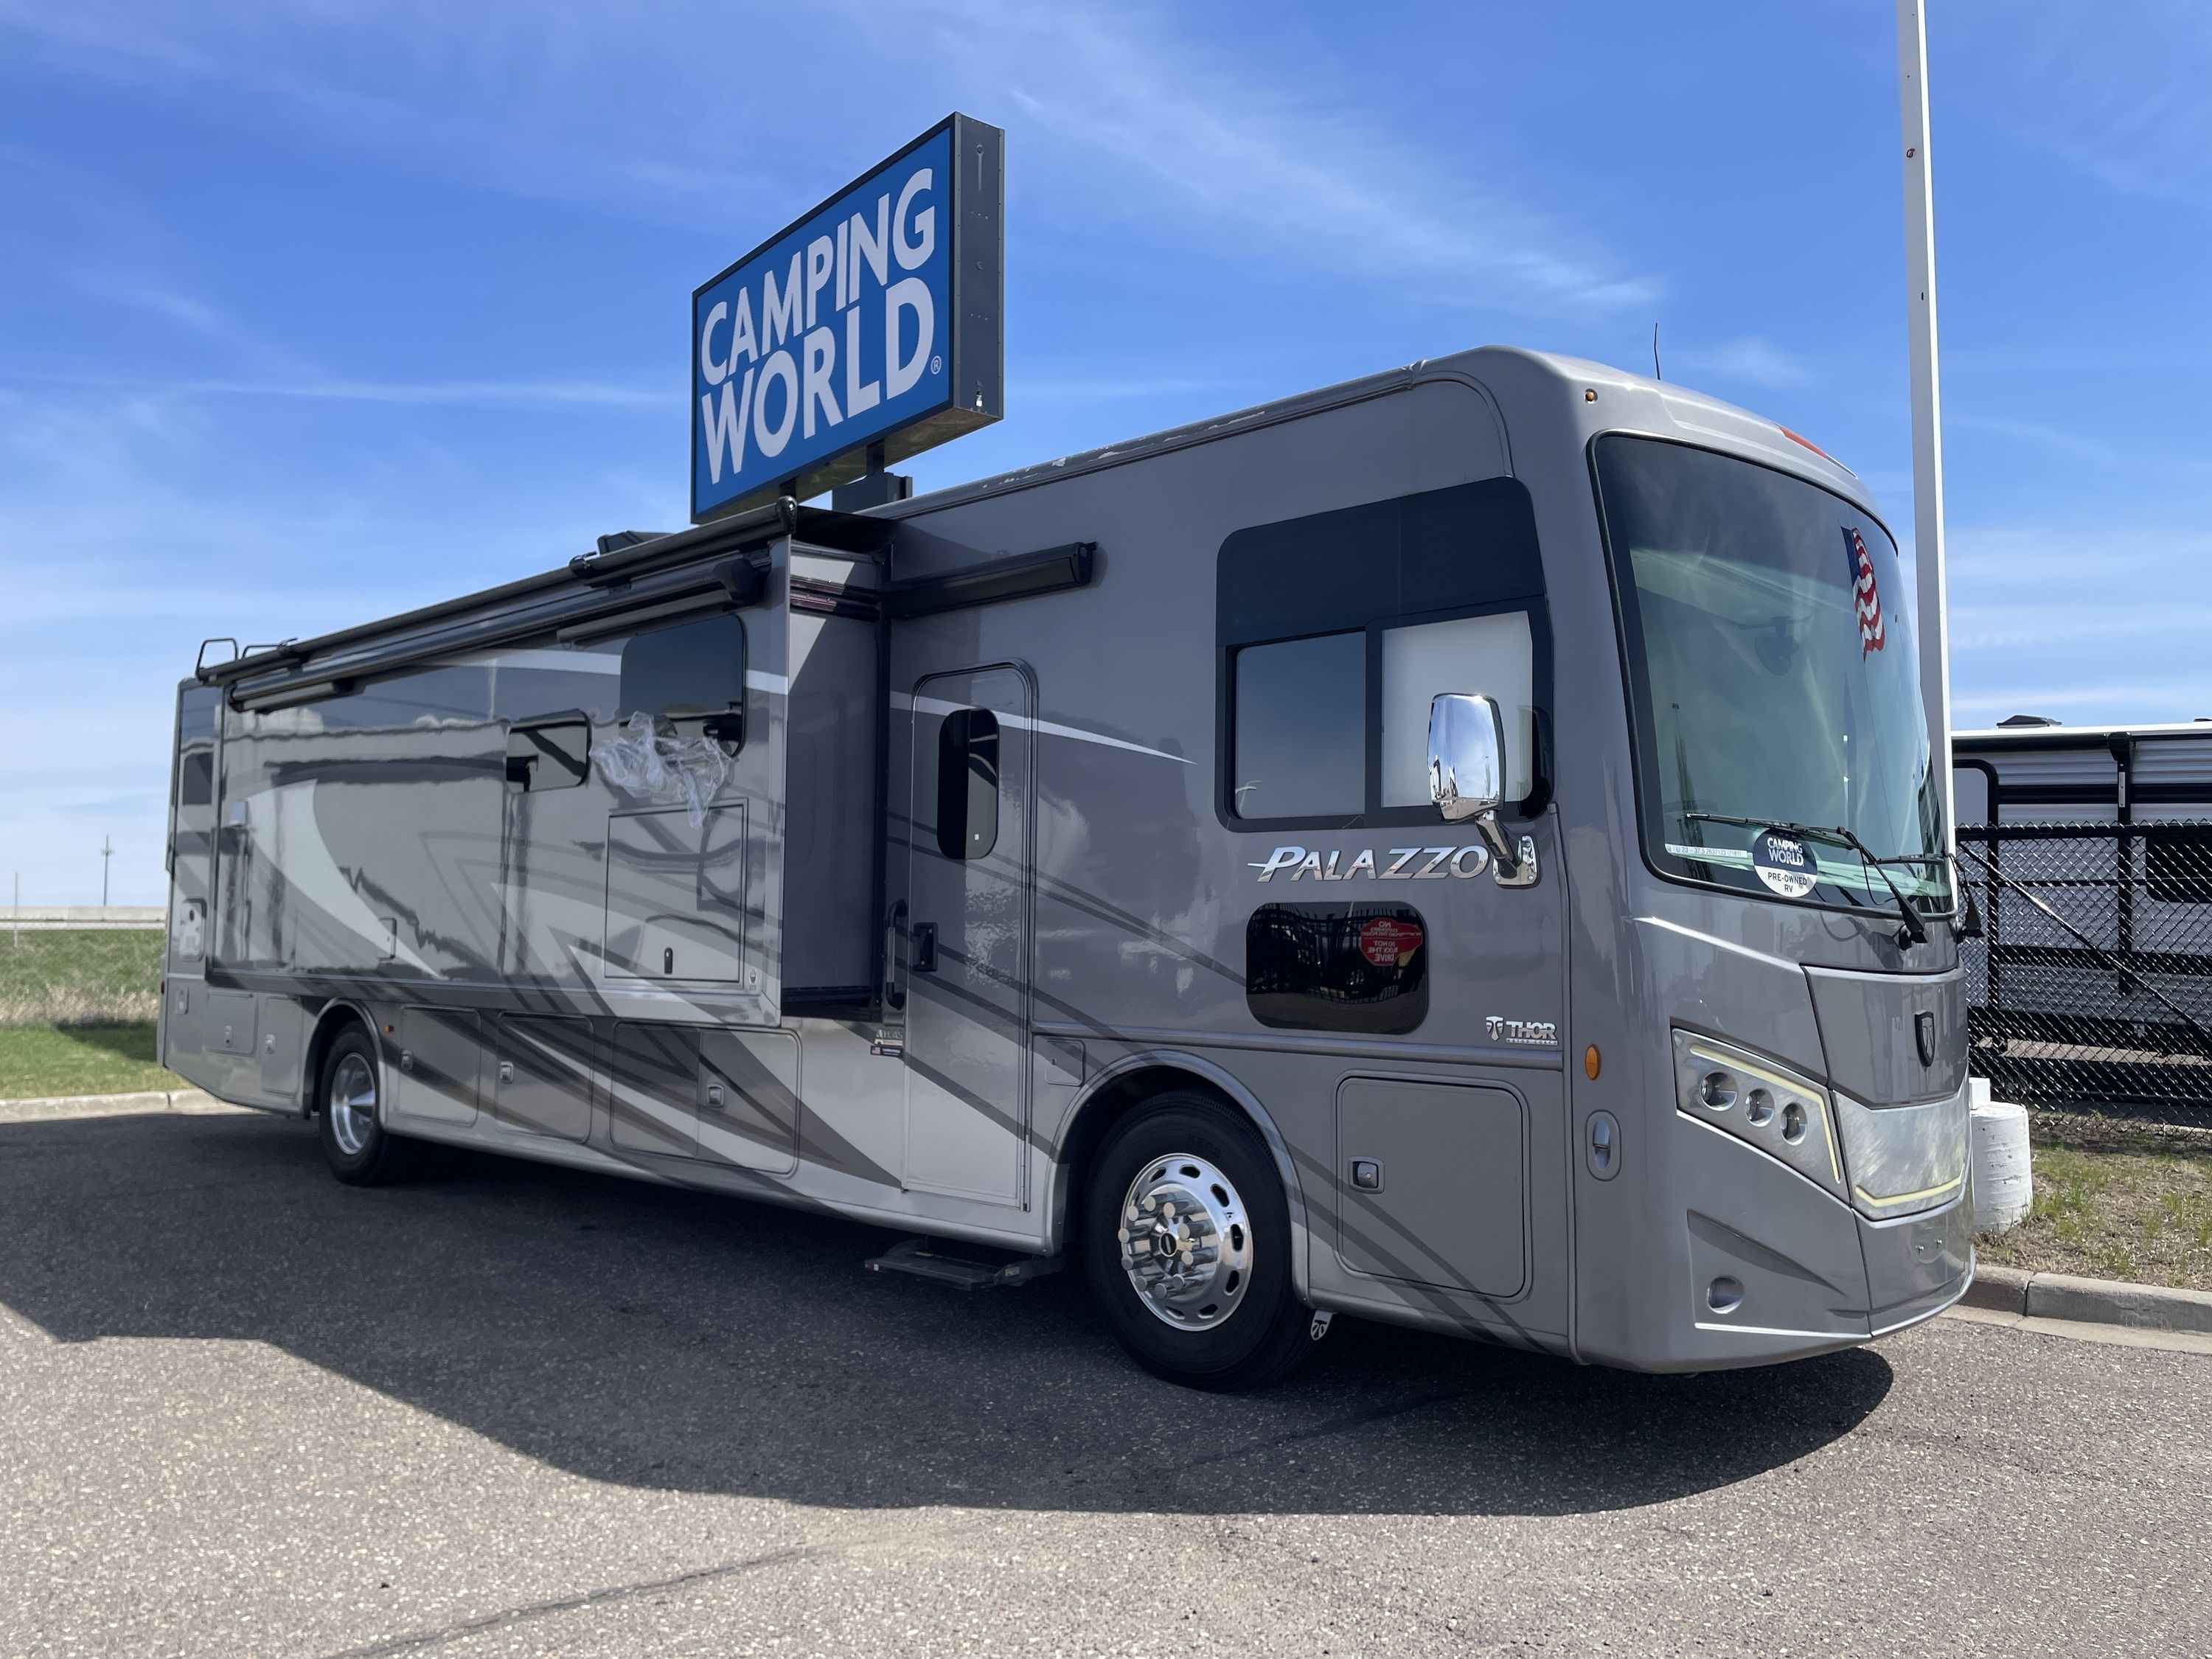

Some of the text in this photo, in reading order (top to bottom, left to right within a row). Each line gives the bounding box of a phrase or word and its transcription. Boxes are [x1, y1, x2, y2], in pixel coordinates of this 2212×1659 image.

[701, 167, 936, 386] CAMPING
[1767, 837, 1803, 854] CAMPING
[1247, 845, 1489, 883] PALAZZO
[1767, 872, 1807, 886] PRE-OWNED
[1784, 884, 1793, 893] RV
[1506, 1020, 1557, 1040] THOR
